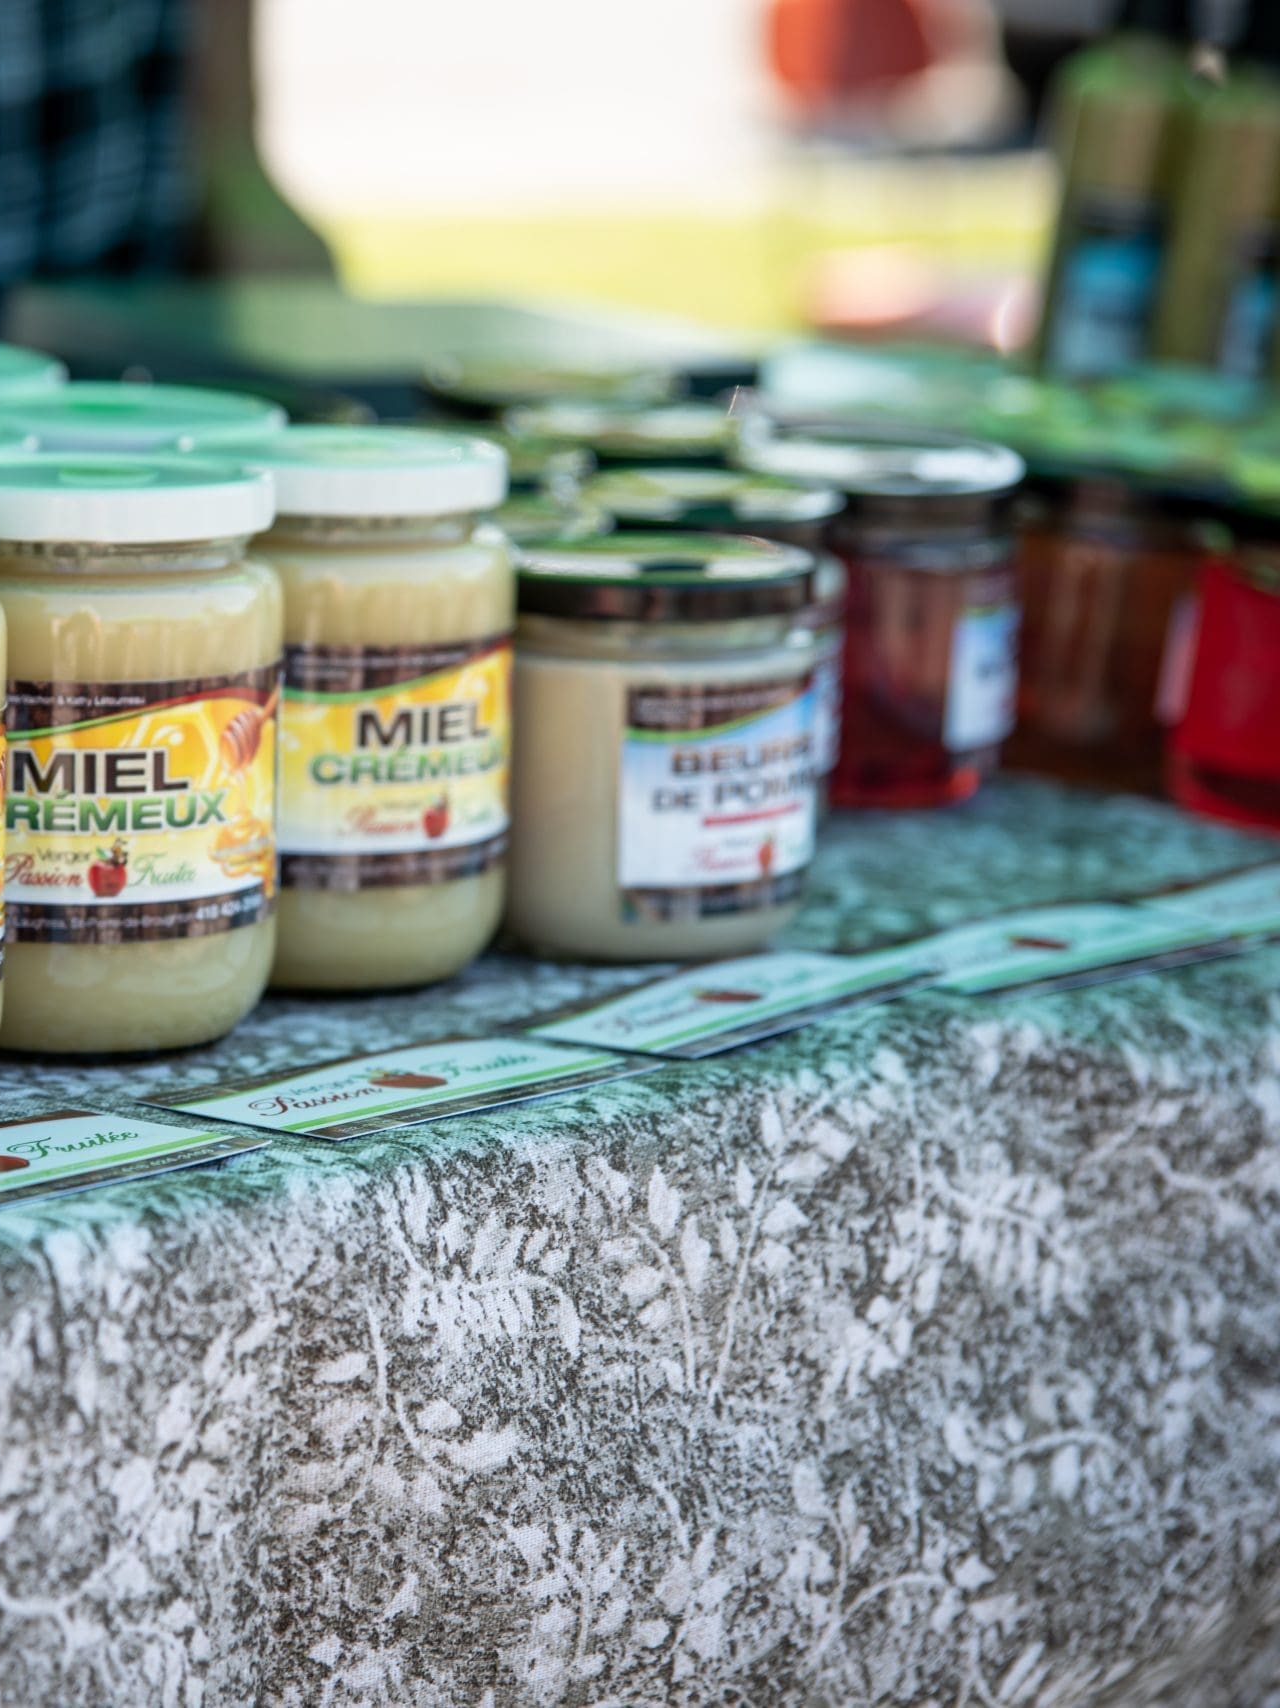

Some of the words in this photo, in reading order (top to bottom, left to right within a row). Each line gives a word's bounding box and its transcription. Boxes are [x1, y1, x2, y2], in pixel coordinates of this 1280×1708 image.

[358, 702, 490, 748] MIEL
[13, 750, 189, 794] MIEL
[311, 741, 504, 786] CRÉMEU
[6, 790, 226, 832] RÉMEUX
